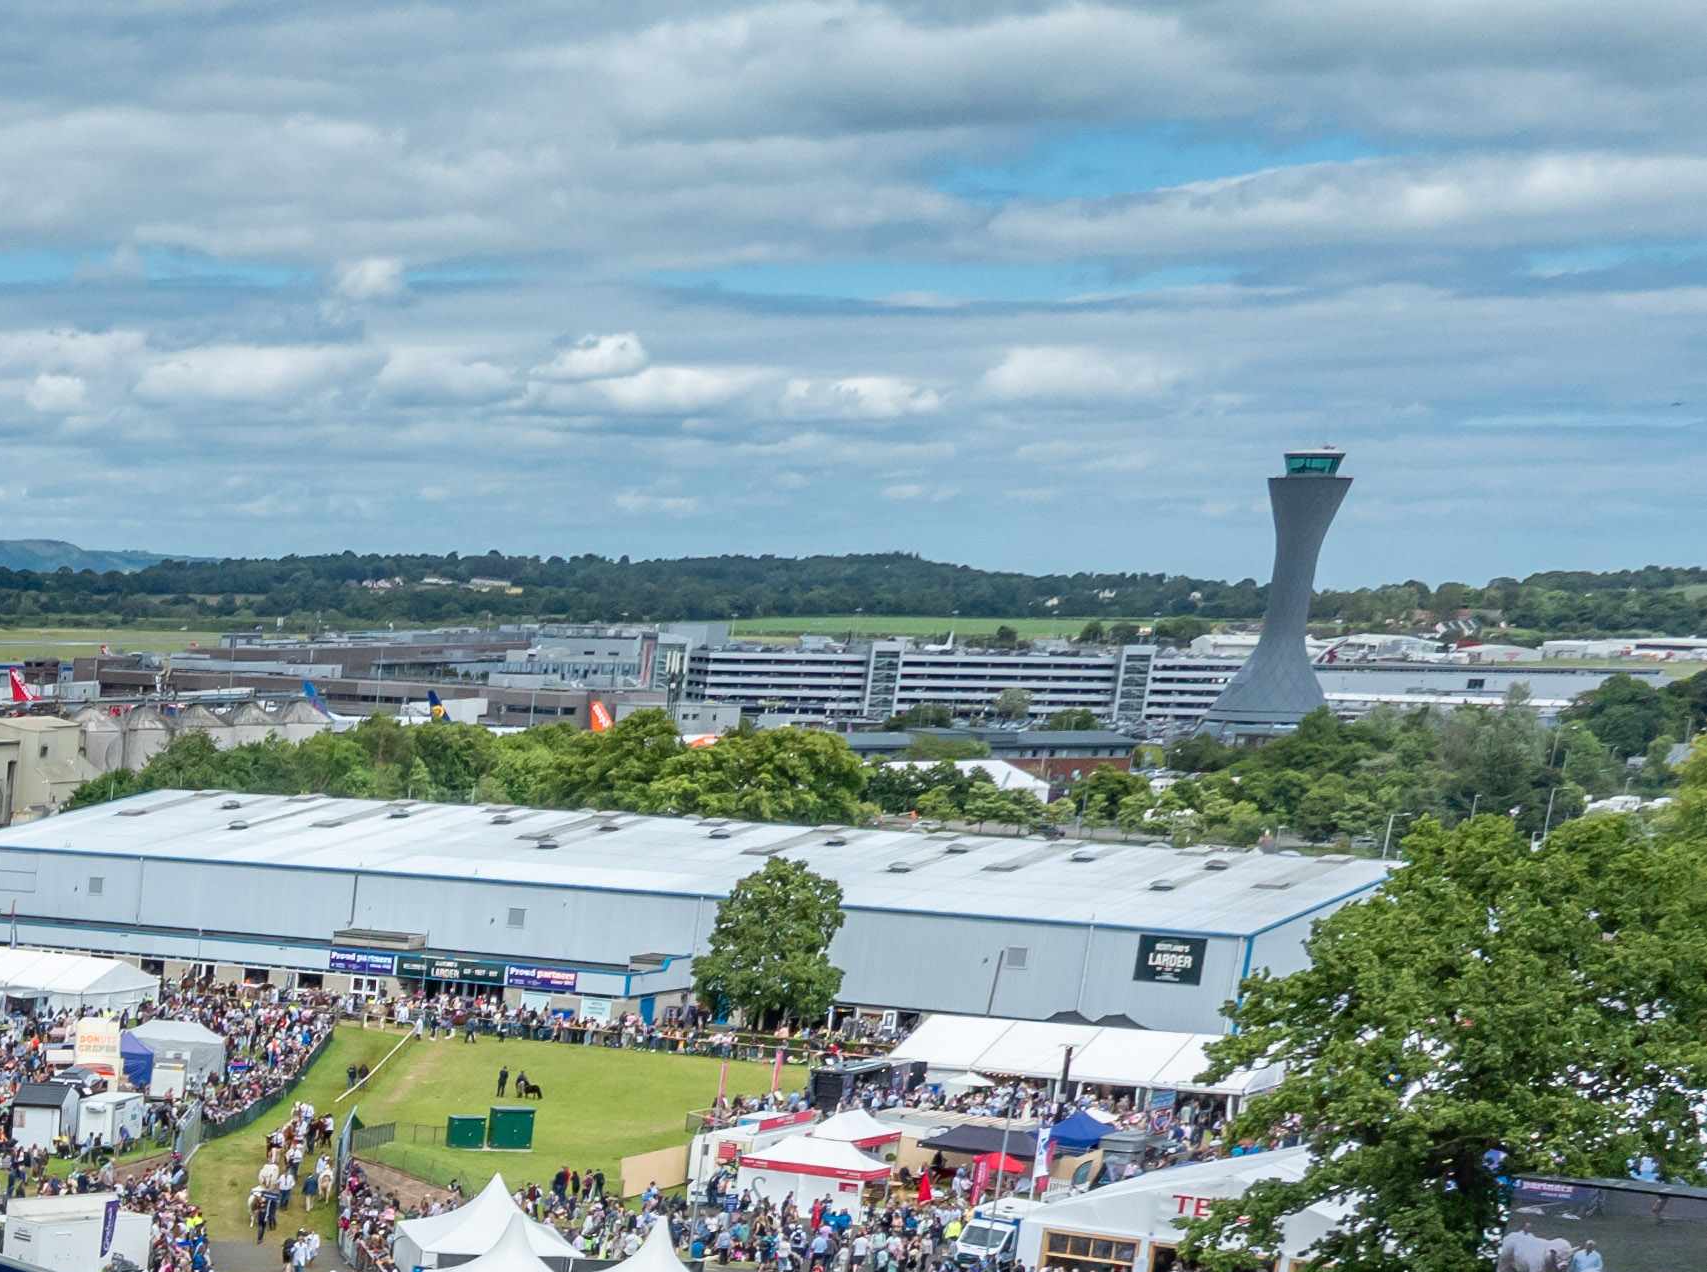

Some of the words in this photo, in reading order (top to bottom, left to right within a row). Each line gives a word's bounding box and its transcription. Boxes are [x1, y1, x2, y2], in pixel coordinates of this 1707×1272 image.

[331, 951, 355, 961] Proud
[1148, 953, 1193, 968] LARDER
[431, 967, 459, 979] LARDER
[510, 967, 535, 977] Proud
[537, 969, 575, 979] partners
